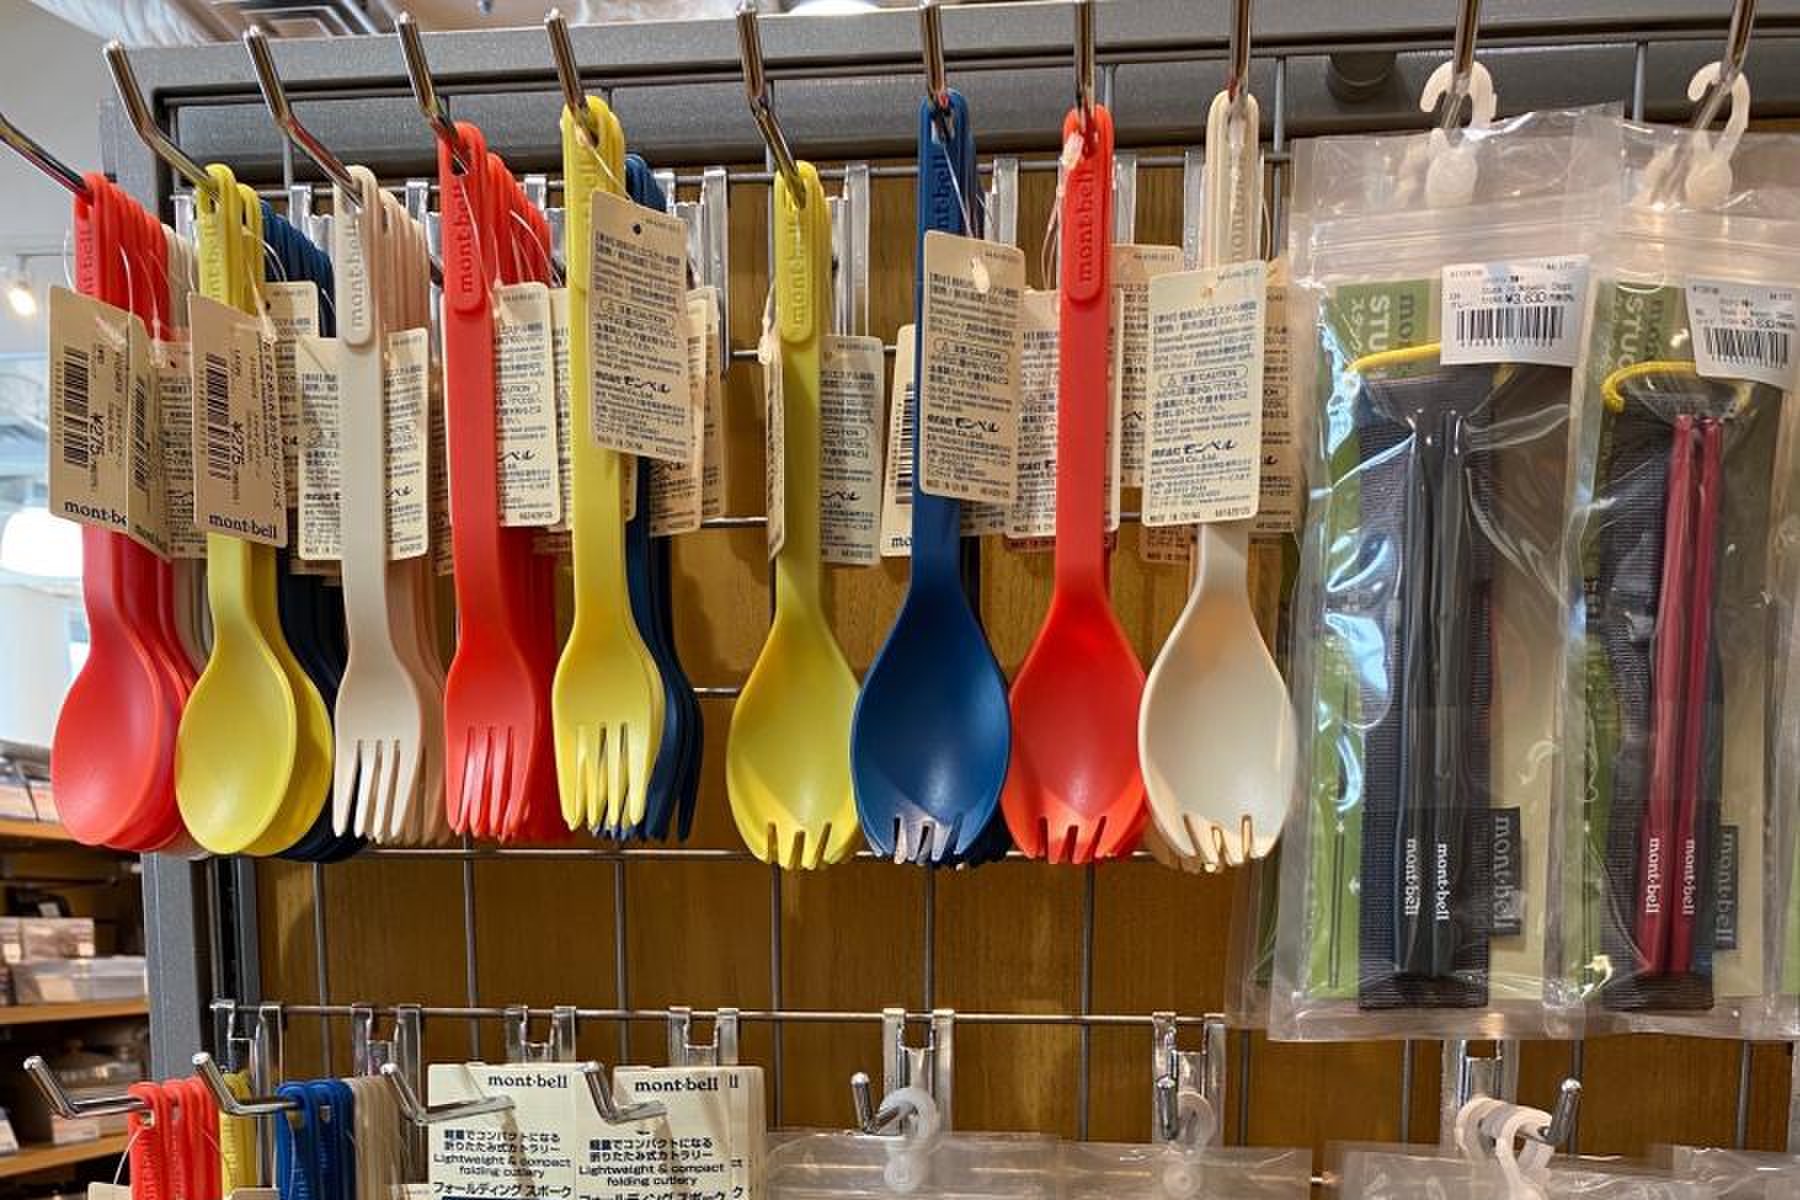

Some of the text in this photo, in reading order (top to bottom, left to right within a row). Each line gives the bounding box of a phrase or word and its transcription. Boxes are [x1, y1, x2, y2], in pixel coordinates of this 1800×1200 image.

[1368, 294, 1391, 352] STU
[433, 1153, 505, 1167] Lightweight
[459, 1165, 500, 1178] folding
[578, 1164, 654, 1177] Lightweight
[671, 1163, 725, 1175] compact
[606, 1176, 698, 1188] folding cutlery
[432, 1181, 572, 1198] フォールディング スポーク
